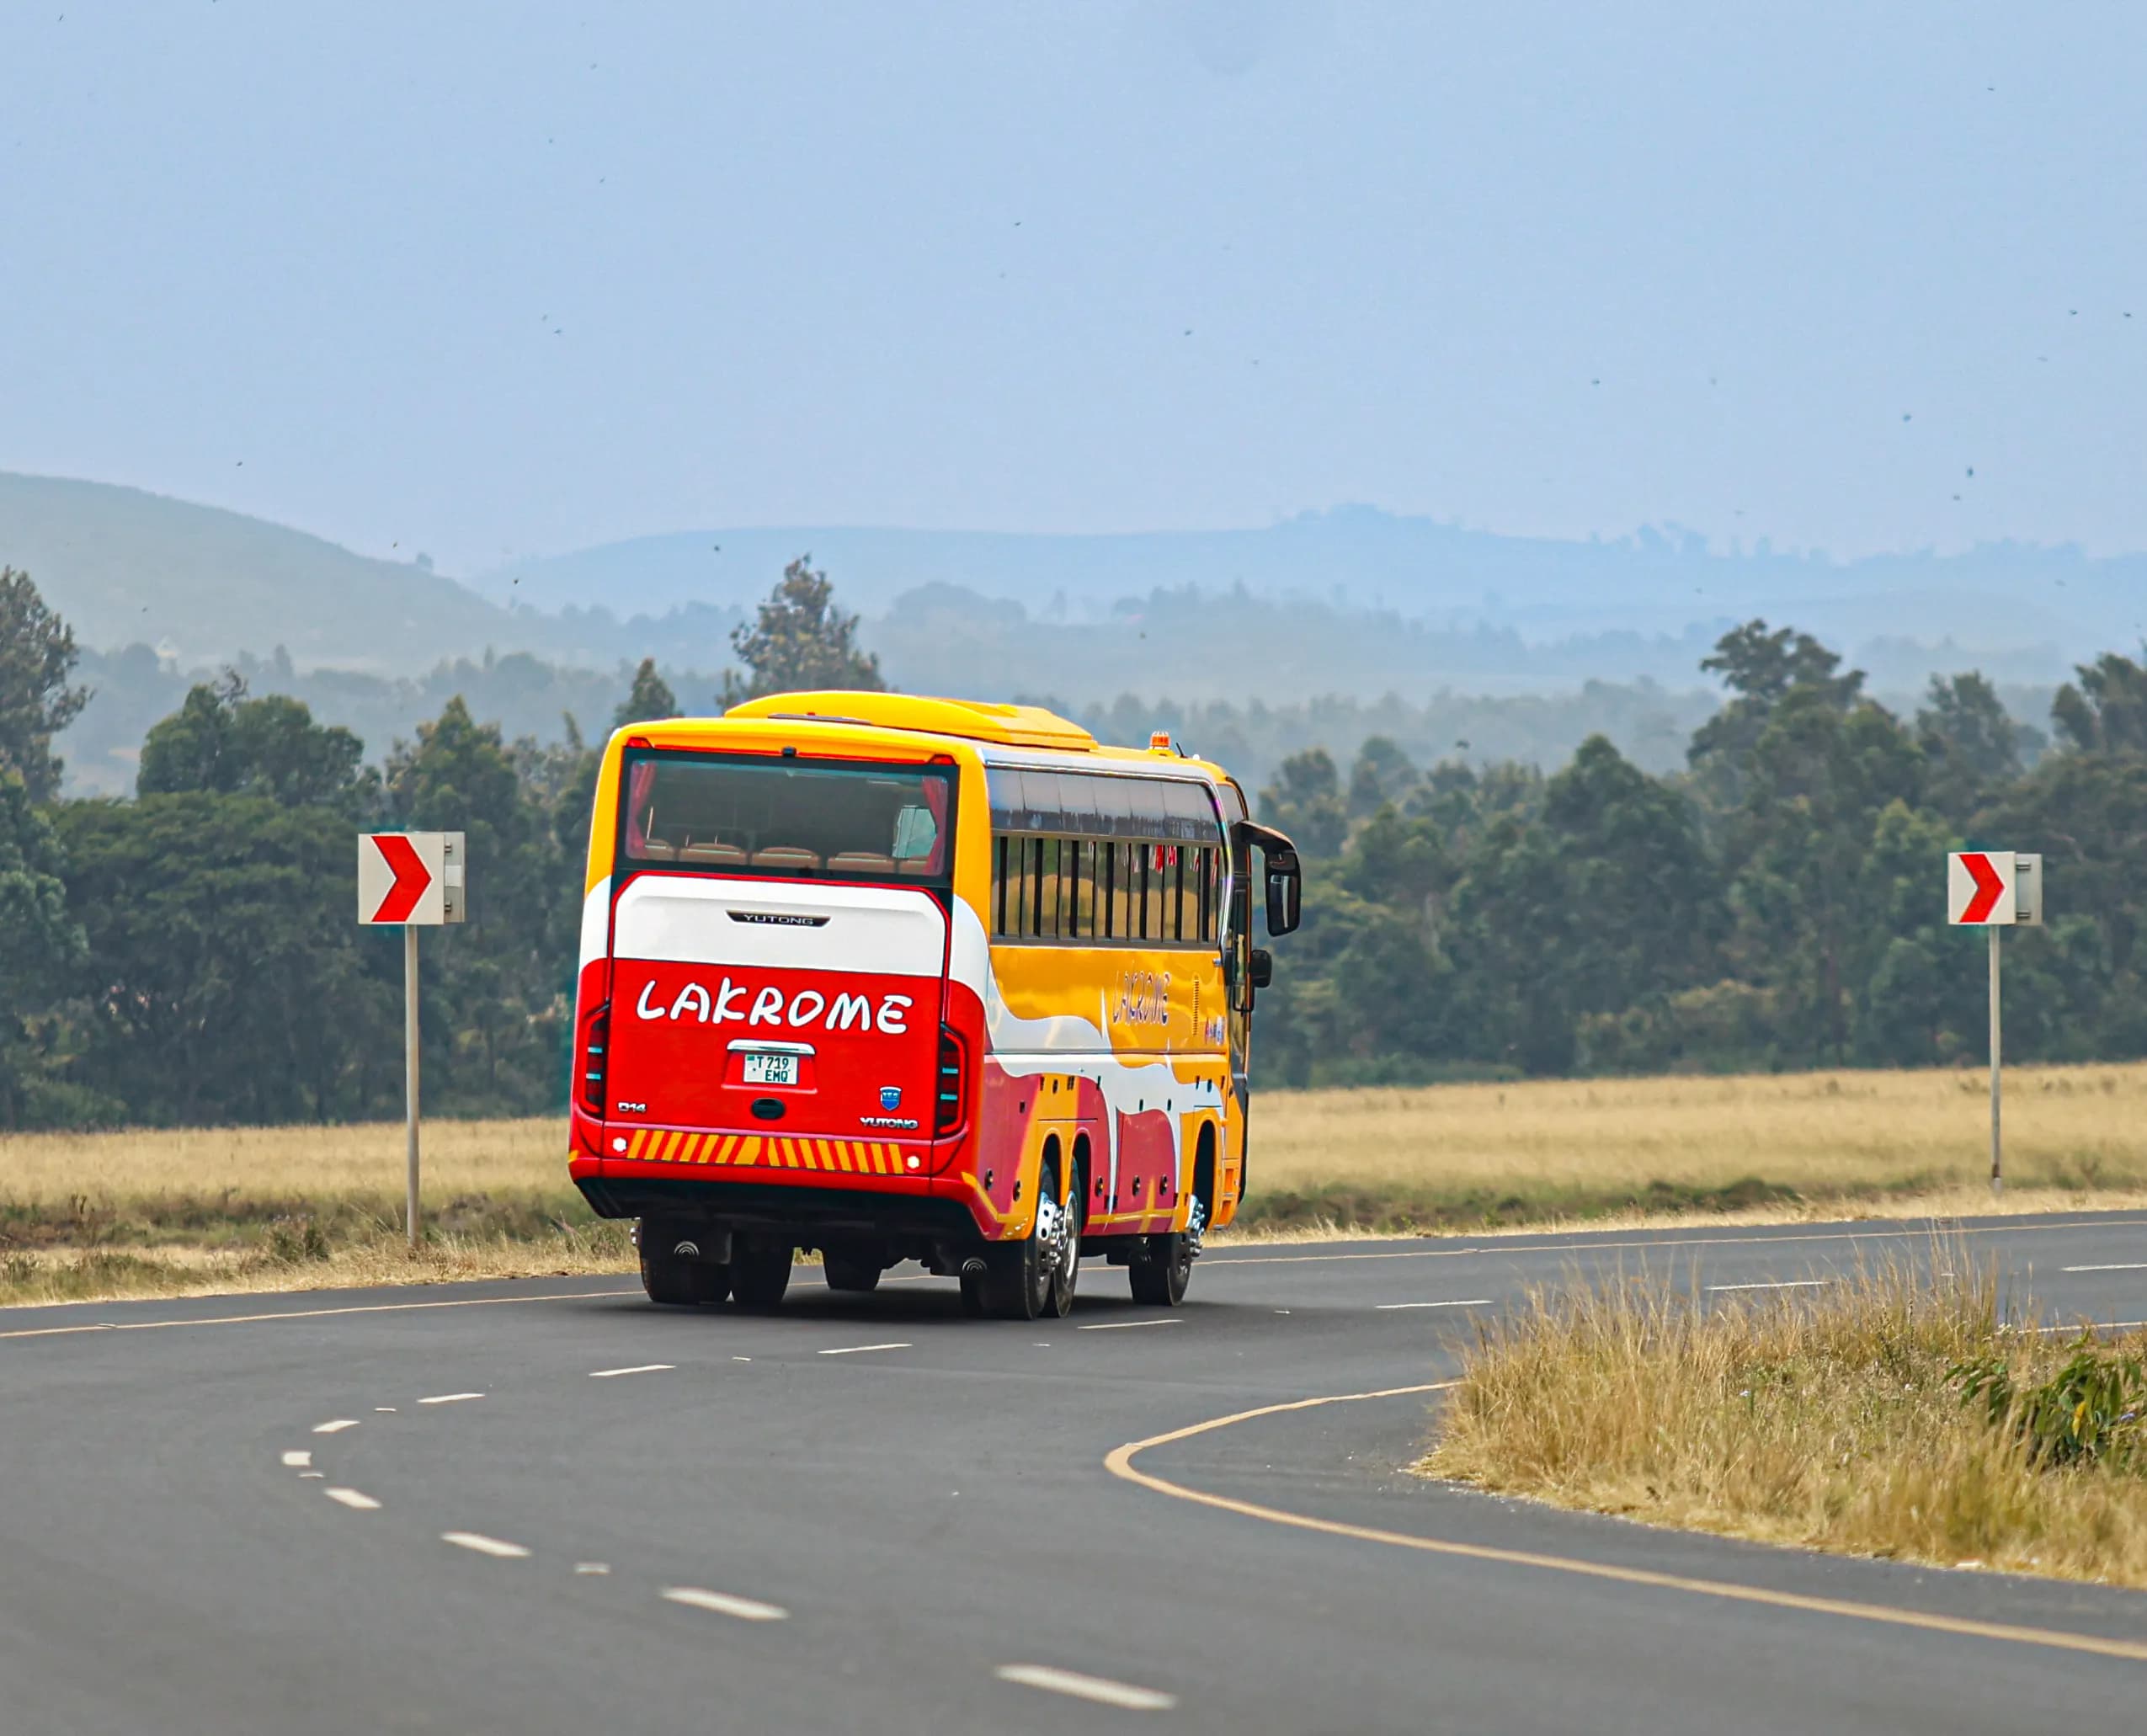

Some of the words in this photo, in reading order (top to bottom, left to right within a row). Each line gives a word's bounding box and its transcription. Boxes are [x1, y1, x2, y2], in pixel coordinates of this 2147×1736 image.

[743, 914, 813, 924] YUTONG
[637, 977, 914, 1034] LAKROME
[757, 1056, 764, 1068] T
[767, 1056, 789, 1069] 719
[765, 1069, 789, 1083] EMQ
[618, 1101, 646, 1112] D14
[860, 1116, 919, 1129] YUTONG
